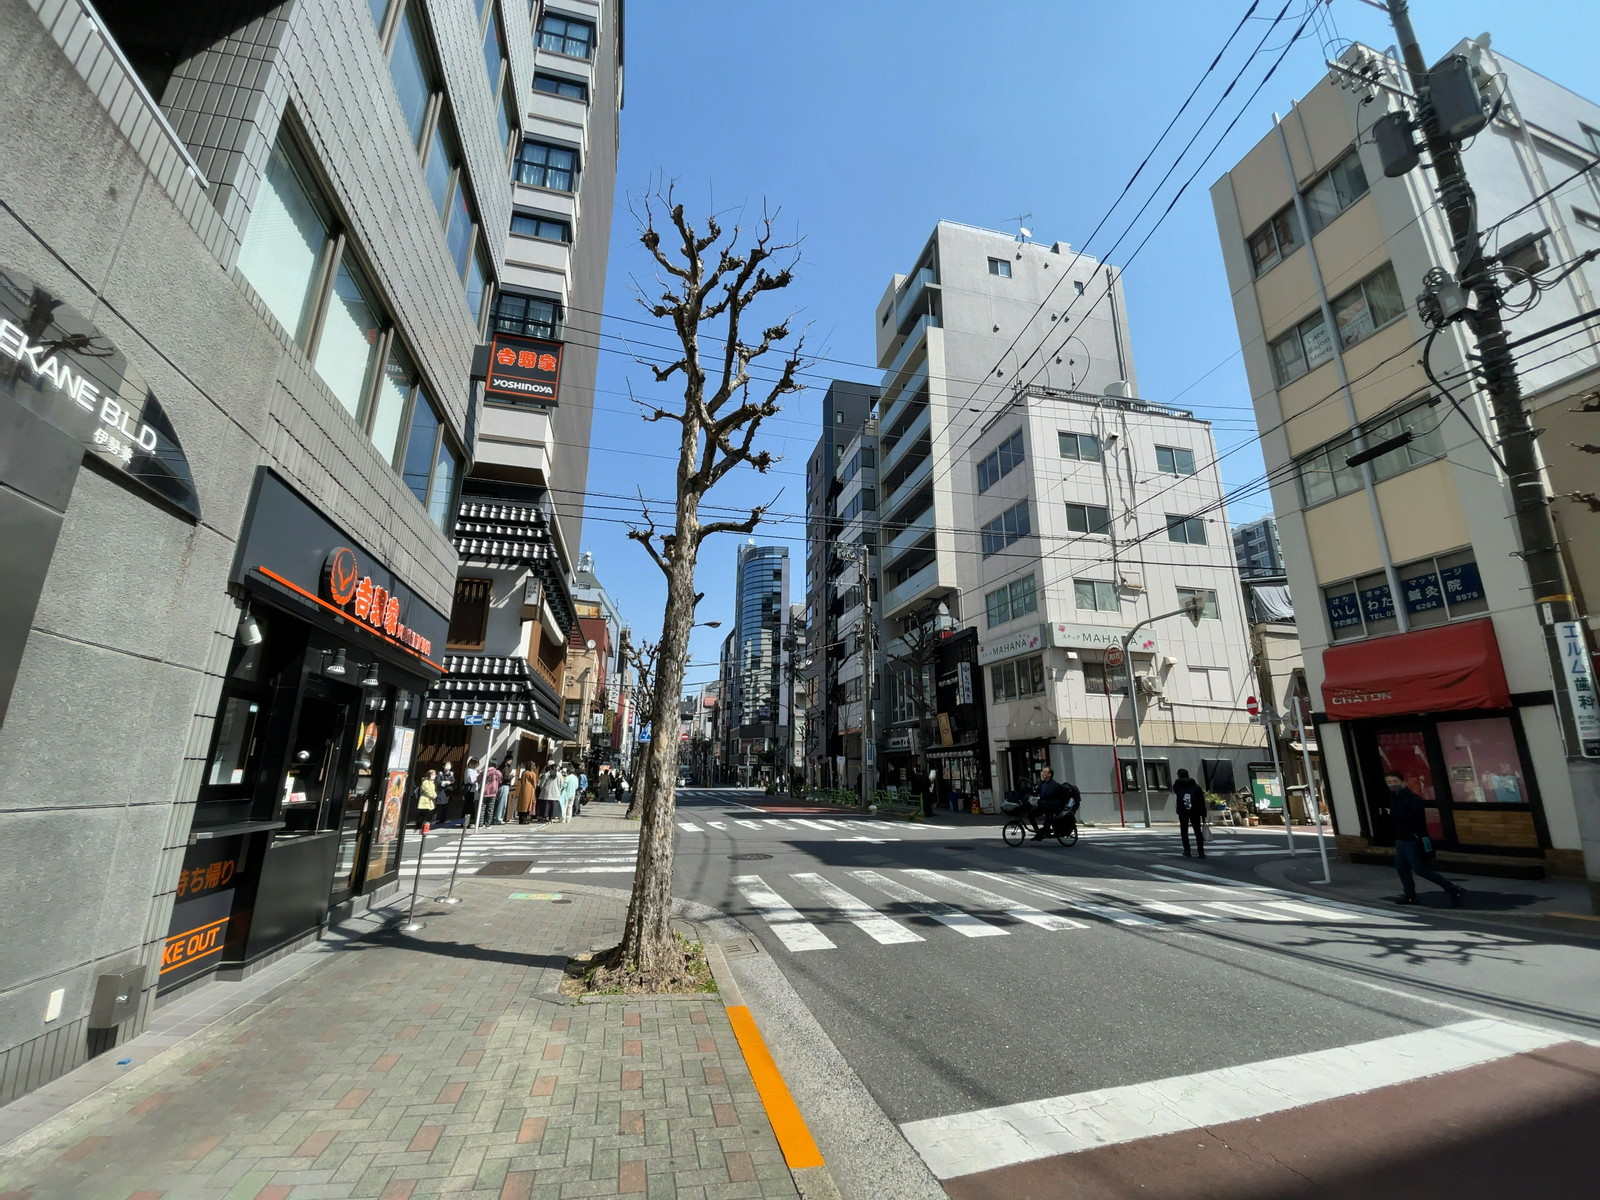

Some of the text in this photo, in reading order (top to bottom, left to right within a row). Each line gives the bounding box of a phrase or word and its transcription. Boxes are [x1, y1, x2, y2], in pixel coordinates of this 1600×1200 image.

[497, 347, 557, 373] 吉野家
[493, 378, 554, 395] YOSHINOYA
[355, 575, 400, 637] 吉野家
[1369, 612, 1385, 620] TEL
[992, 638, 1027, 656] MAHANA
[1082, 632, 1139, 646] MAHAA
[1562, 625, 1596, 710] エルム歯科
[1331, 692, 1392, 705] CHATON
[186, 926, 221, 956] OUT
